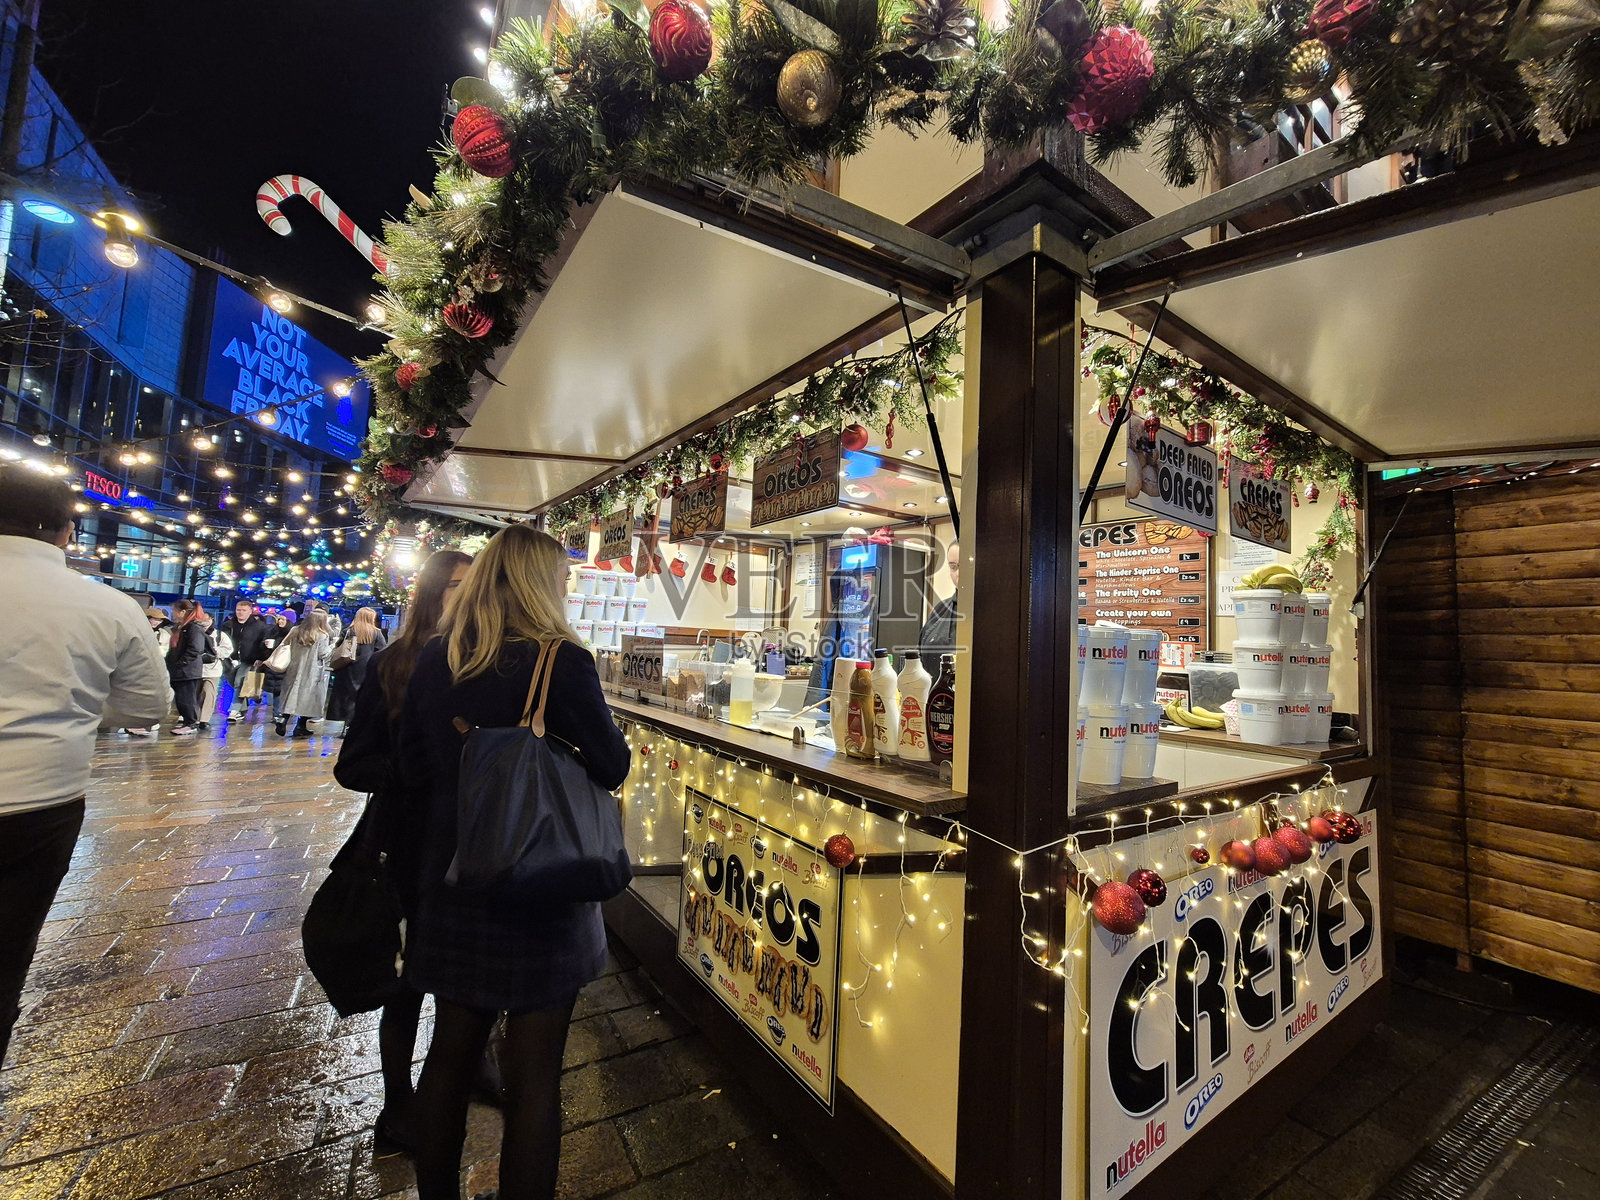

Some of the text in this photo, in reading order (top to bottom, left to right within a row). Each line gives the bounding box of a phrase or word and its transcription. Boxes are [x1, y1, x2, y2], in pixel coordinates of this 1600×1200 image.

[261, 304, 307, 349] NOT
[252, 322, 308, 377] YOUR
[222, 337, 325, 408] AVERAGE
[238, 367, 309, 423] BLACK
[231, 390, 309, 445] FRDAY.
[764, 455, 822, 498] OREOS
[1160, 440, 1212, 481] DEEP FRIED
[86, 471, 120, 499] TESCO
[679, 486, 717, 513] CREPES
[1159, 466, 1214, 518] OREOS
[1241, 478, 1282, 516] CREPES
[604, 524, 626, 544] OREOS
[1079, 523, 1138, 548] EPES
[1096, 546, 1170, 559] The Unicorn One
[1109, 568, 1134, 576] Kinder
[1134, 566, 1161, 577] Suprise
[1163, 566, 1179, 574] One
[1096, 588, 1162, 598] The Fruity One
[1095, 609, 1172, 619] Create your own
[622, 652, 661, 683] OREOS
[1253, 653, 1283, 662] nutell
[1156, 691, 1187, 700] nutella
[773, 852, 798, 874] nutella
[702, 842, 821, 967] OREOS
[1175, 878, 1213, 921] OREO
[719, 974, 740, 999] nutella
[1107, 846, 1374, 1117] CREPES
[1328, 976, 1349, 1012] OREO
[1285, 1000, 1318, 1042] nutella
[792, 1043, 822, 1079] nutella
[1184, 1073, 1223, 1130] OREO
[1106, 1118, 1166, 1192] nutella
